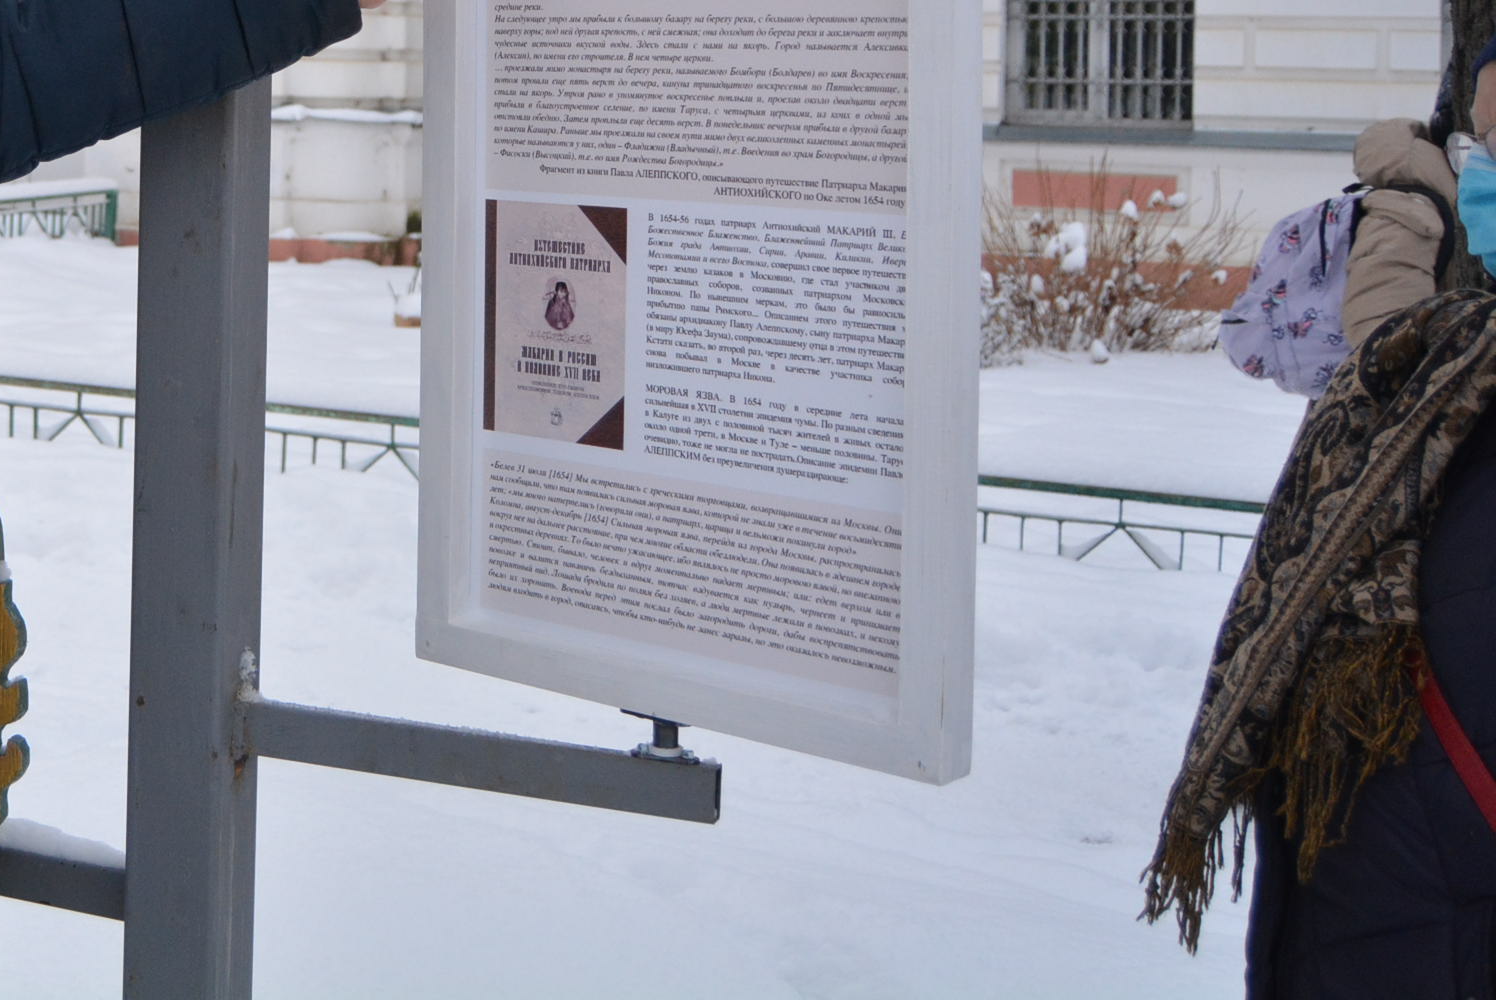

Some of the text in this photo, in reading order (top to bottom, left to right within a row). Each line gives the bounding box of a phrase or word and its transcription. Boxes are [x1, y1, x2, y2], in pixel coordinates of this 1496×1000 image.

[683, 55, 713, 64] церкви.
[539, 164, 574, 174] Фрагмент
[610, 167, 633, 177] Павла
[635, 169, 700, 181] АЛЕППСКОГО,
[702, 175, 763, 184] описывающего
[765, 178, 819, 188] путешествие
[821, 178, 867, 192] Патриарха
[714, 187, 802, 200] АНТИОХИЙСКОГО
[815, 193, 832, 202] Оке
[835, 196, 861, 204] летом
[864, 195, 884, 205] 1654
[886, 199, 904, 209] году
[660, 214, 689, 223] 1654-56
[694, 218, 715, 226] годах
[721, 220, 756, 230] патриарх
[762, 221, 821, 233] Антиохийский
[827, 225, 876, 237] МАКАРИЙ
[647, 264, 667, 272] через
[703, 269, 733, 277] казаков
[750, 270, 795, 283] Московию,
[820, 279, 838, 287] стал
[845, 281, 890, 291] участником
[647, 276, 852, 301] православных соборов, созванных патриархом
[702, 368, 741, 379] патриарха
[743, 371, 775, 383] Никона.
[646, 383, 688, 397] МОРОВАЯ
[744, 397, 762, 406] 1654
[769, 401, 786, 412] году
[806, 407, 842, 417] середине
[849, 412, 868, 421] лета
[697, 402, 716, 413] XVII
[646, 445, 700, 461] АЛЕППСКИМ
[716, 458, 774, 472] преувеличения
[548, 469, 573, 482] [1654]
[575, 473, 589, 483] Мы
[590, 479, 641, 492] встретились
[696, 496, 748, 510] торговцами,
[844, 518, 881, 532] Москвы.
